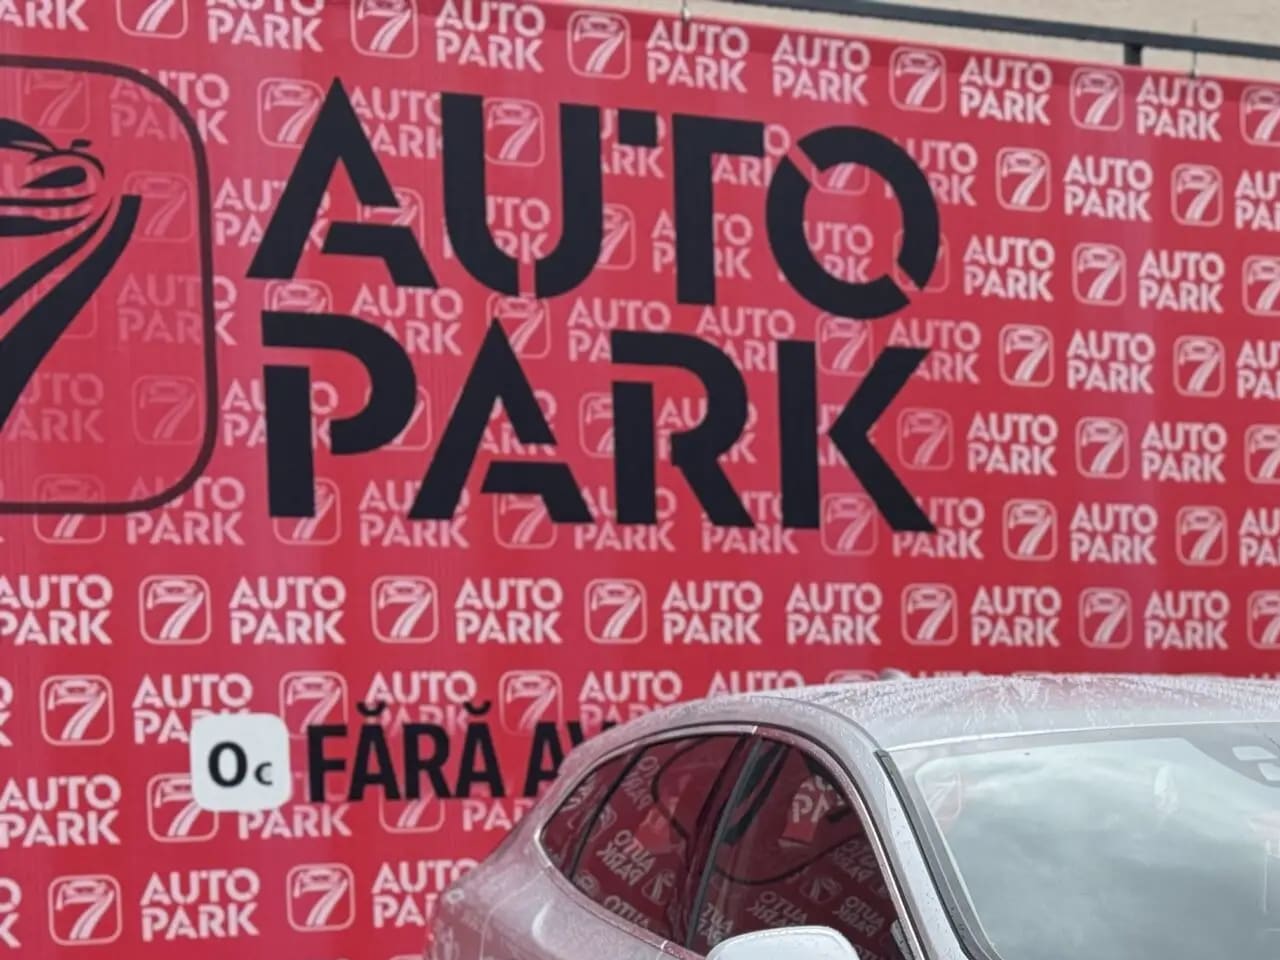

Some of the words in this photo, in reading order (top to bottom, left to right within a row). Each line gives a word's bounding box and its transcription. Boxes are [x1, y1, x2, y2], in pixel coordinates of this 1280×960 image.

[0, 0, 88, 32] ARK
[208, 9, 324, 52] PARK
[436, 0, 545, 38] AUTO
[436, 27, 543, 73] PARK
[647, 17, 749, 58] AUTO
[773, 32, 870, 71] AUTO
[647, 50, 747, 94] PARK
[773, 63, 867, 106] PARK
[959, 55, 1052, 92] AUTO
[960, 84, 1050, 125] PARK
[1137, 74, 1223, 110] AUTO
[1137, 103, 1221, 142] PARK
[893, 137, 978, 174] UTO
[1064, 154, 1153, 191] AUTO
[246, 76, 940, 320] AUTO
[1065, 183, 1151, 223] PARK
[964, 235, 1055, 270] AUTO
[1138, 249, 1224, 283] AUTO
[964, 264, 1053, 302] PARK
[1139, 277, 1222, 314] PARK
[350, 283, 464, 321] AUTO
[567, 297, 671, 332] AUTO
[696, 305, 796, 339] AUTO
[887, 318, 981, 352] AUTO
[1067, 330, 1155, 363] AUTO
[1068, 358, 1153, 394] PARK
[261, 312, 937, 533] PARK
[967, 412, 1058, 444] AUTO
[1141, 421, 1227, 453] AUTO
[968, 441, 1056, 477] PARK
[1142, 450, 1225, 483] PARK
[126, 512, 245, 545] PARK
[359, 514, 469, 547] PARK
[1070, 502, 1158, 534] AUTO
[1071, 531, 1156, 565] PARK
[0, 574, 112, 609] AUTO
[229, 576, 346, 610] AUTO
[455, 577, 563, 610] AUTO
[662, 580, 763, 612] AUTO
[786, 582, 882, 613] AUTO
[971, 585, 1061, 616] AUTO
[1144, 590, 1230, 620] AUTO
[0, 608, 112, 645] PARK
[231, 609, 344, 644] PARK
[456, 609, 561, 644] PARK
[663, 611, 761, 645] PARK
[787, 612, 880, 645] PARK
[972, 615, 1059, 647] PARK
[1145, 619, 1228, 650] PARK
[132, 673, 253, 708] AUTO
[365, 671, 477, 703] AUTO
[579, 670, 682, 702] AUTO
[307, 701, 507, 803] FĂRĂ
[0, 774, 121, 812] AUTO
[0, 810, 120, 848] PARK
[238, 803, 352, 839] PARK
[140, 867, 260, 906] AUTO
[142, 901, 259, 942] PARK
